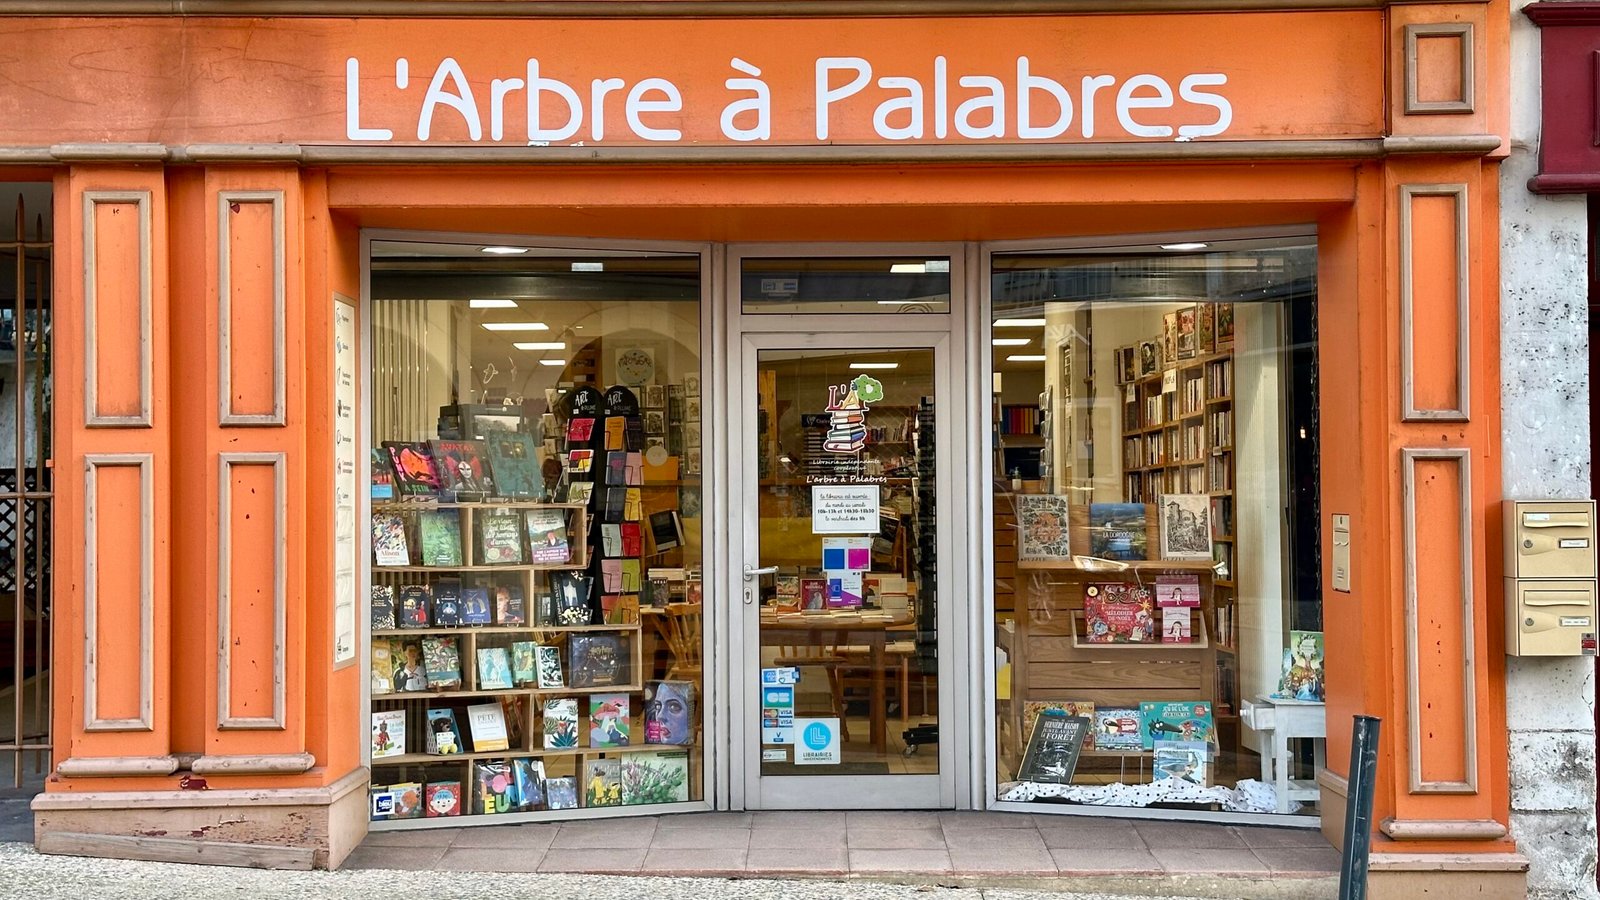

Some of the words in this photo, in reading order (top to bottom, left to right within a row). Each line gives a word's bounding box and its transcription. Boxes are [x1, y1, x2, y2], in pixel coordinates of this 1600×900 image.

[346, 57, 682, 141] L'Arbre
[720, 57, 770, 141] à
[815, 55, 1233, 141] Palabres
[806, 475, 838, 483] L'arbre
[840, 474, 846, 482] à
[850, 475, 888, 483] Palabres
